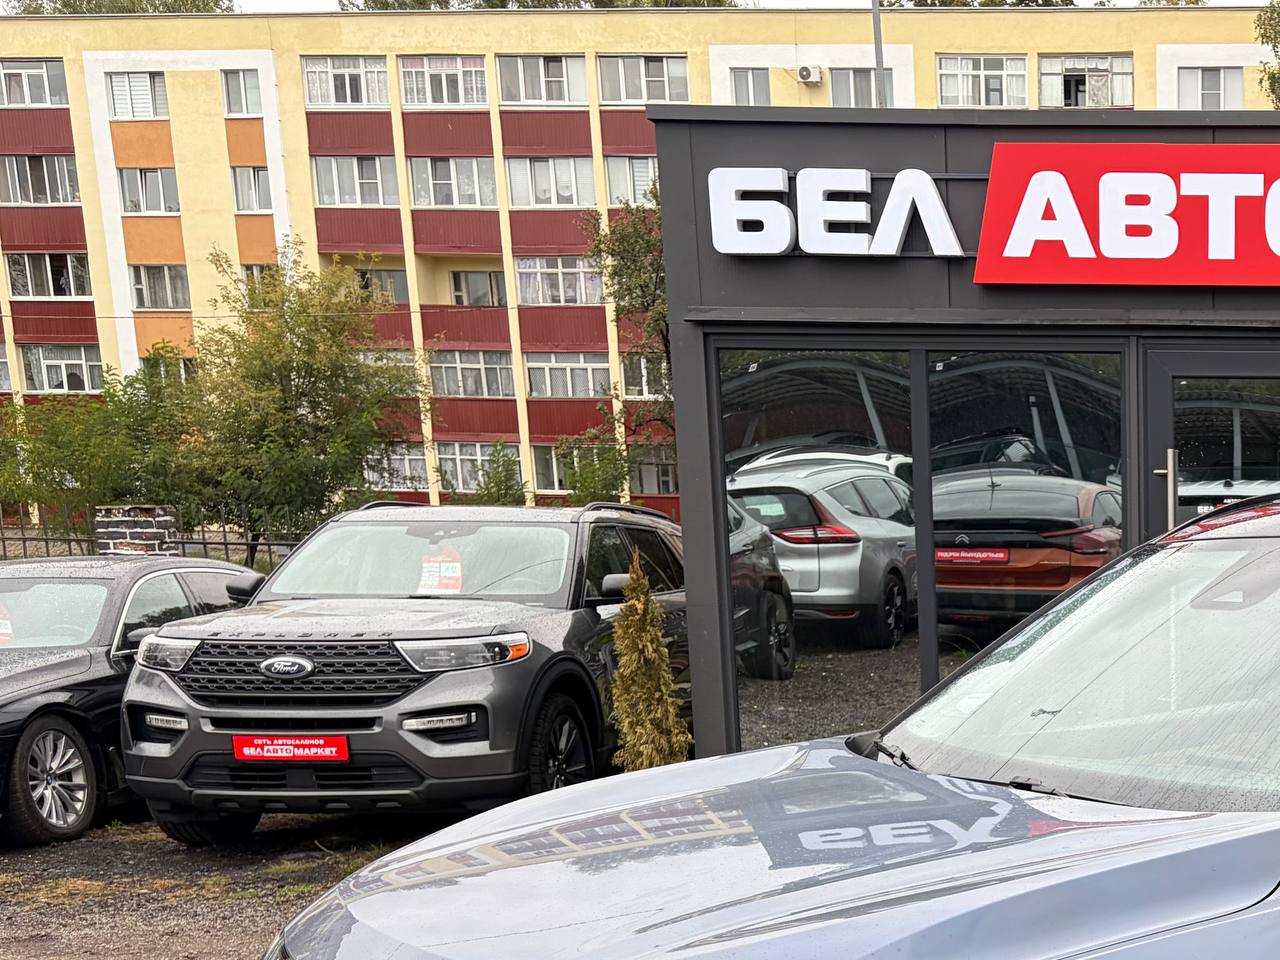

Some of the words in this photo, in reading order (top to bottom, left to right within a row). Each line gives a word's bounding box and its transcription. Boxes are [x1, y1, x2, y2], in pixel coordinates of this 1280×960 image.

[708, 167, 965, 256] БЕЛ
[271, 661, 299, 673] Ford
[265, 747, 292, 755] АВТО
[294, 748, 338, 756] МАРКЕТ
